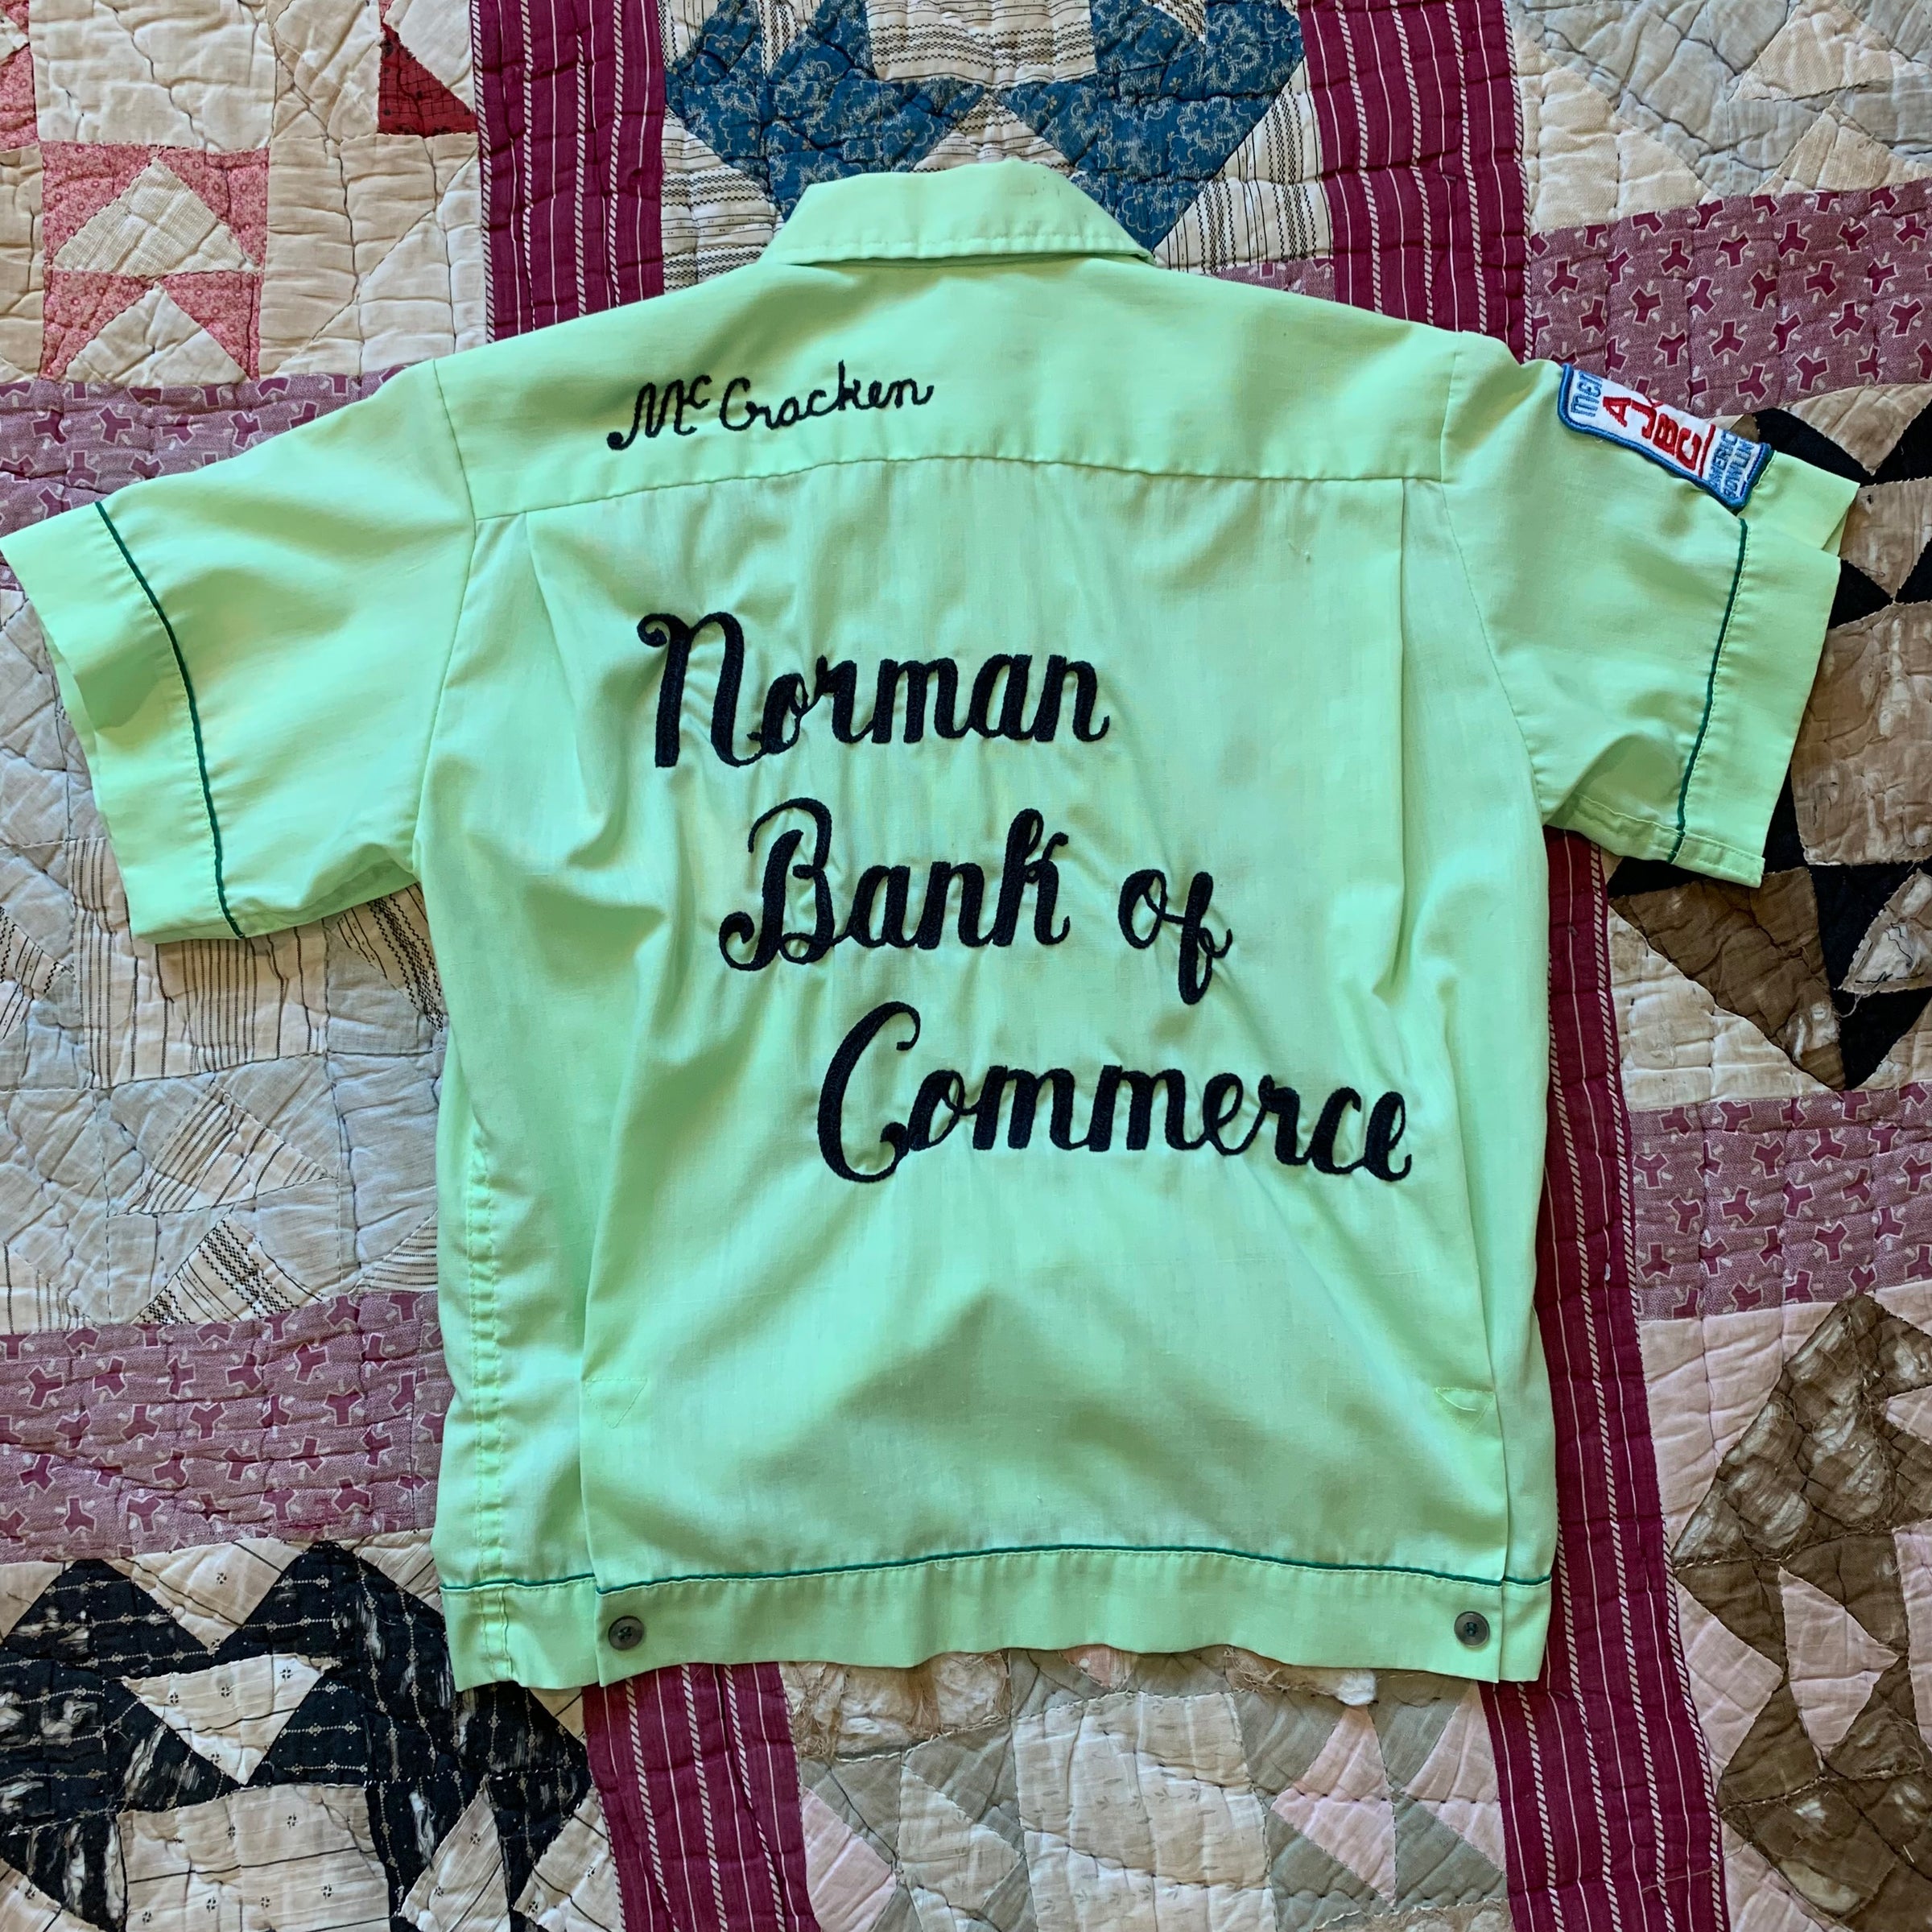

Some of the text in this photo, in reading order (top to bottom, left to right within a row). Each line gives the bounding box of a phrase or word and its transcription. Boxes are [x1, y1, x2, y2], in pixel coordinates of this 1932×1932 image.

[637, 612, 1109, 767] Norman
[719, 798, 1232, 1005] Bank of
[818, 1001, 1411, 1183] Commerce
